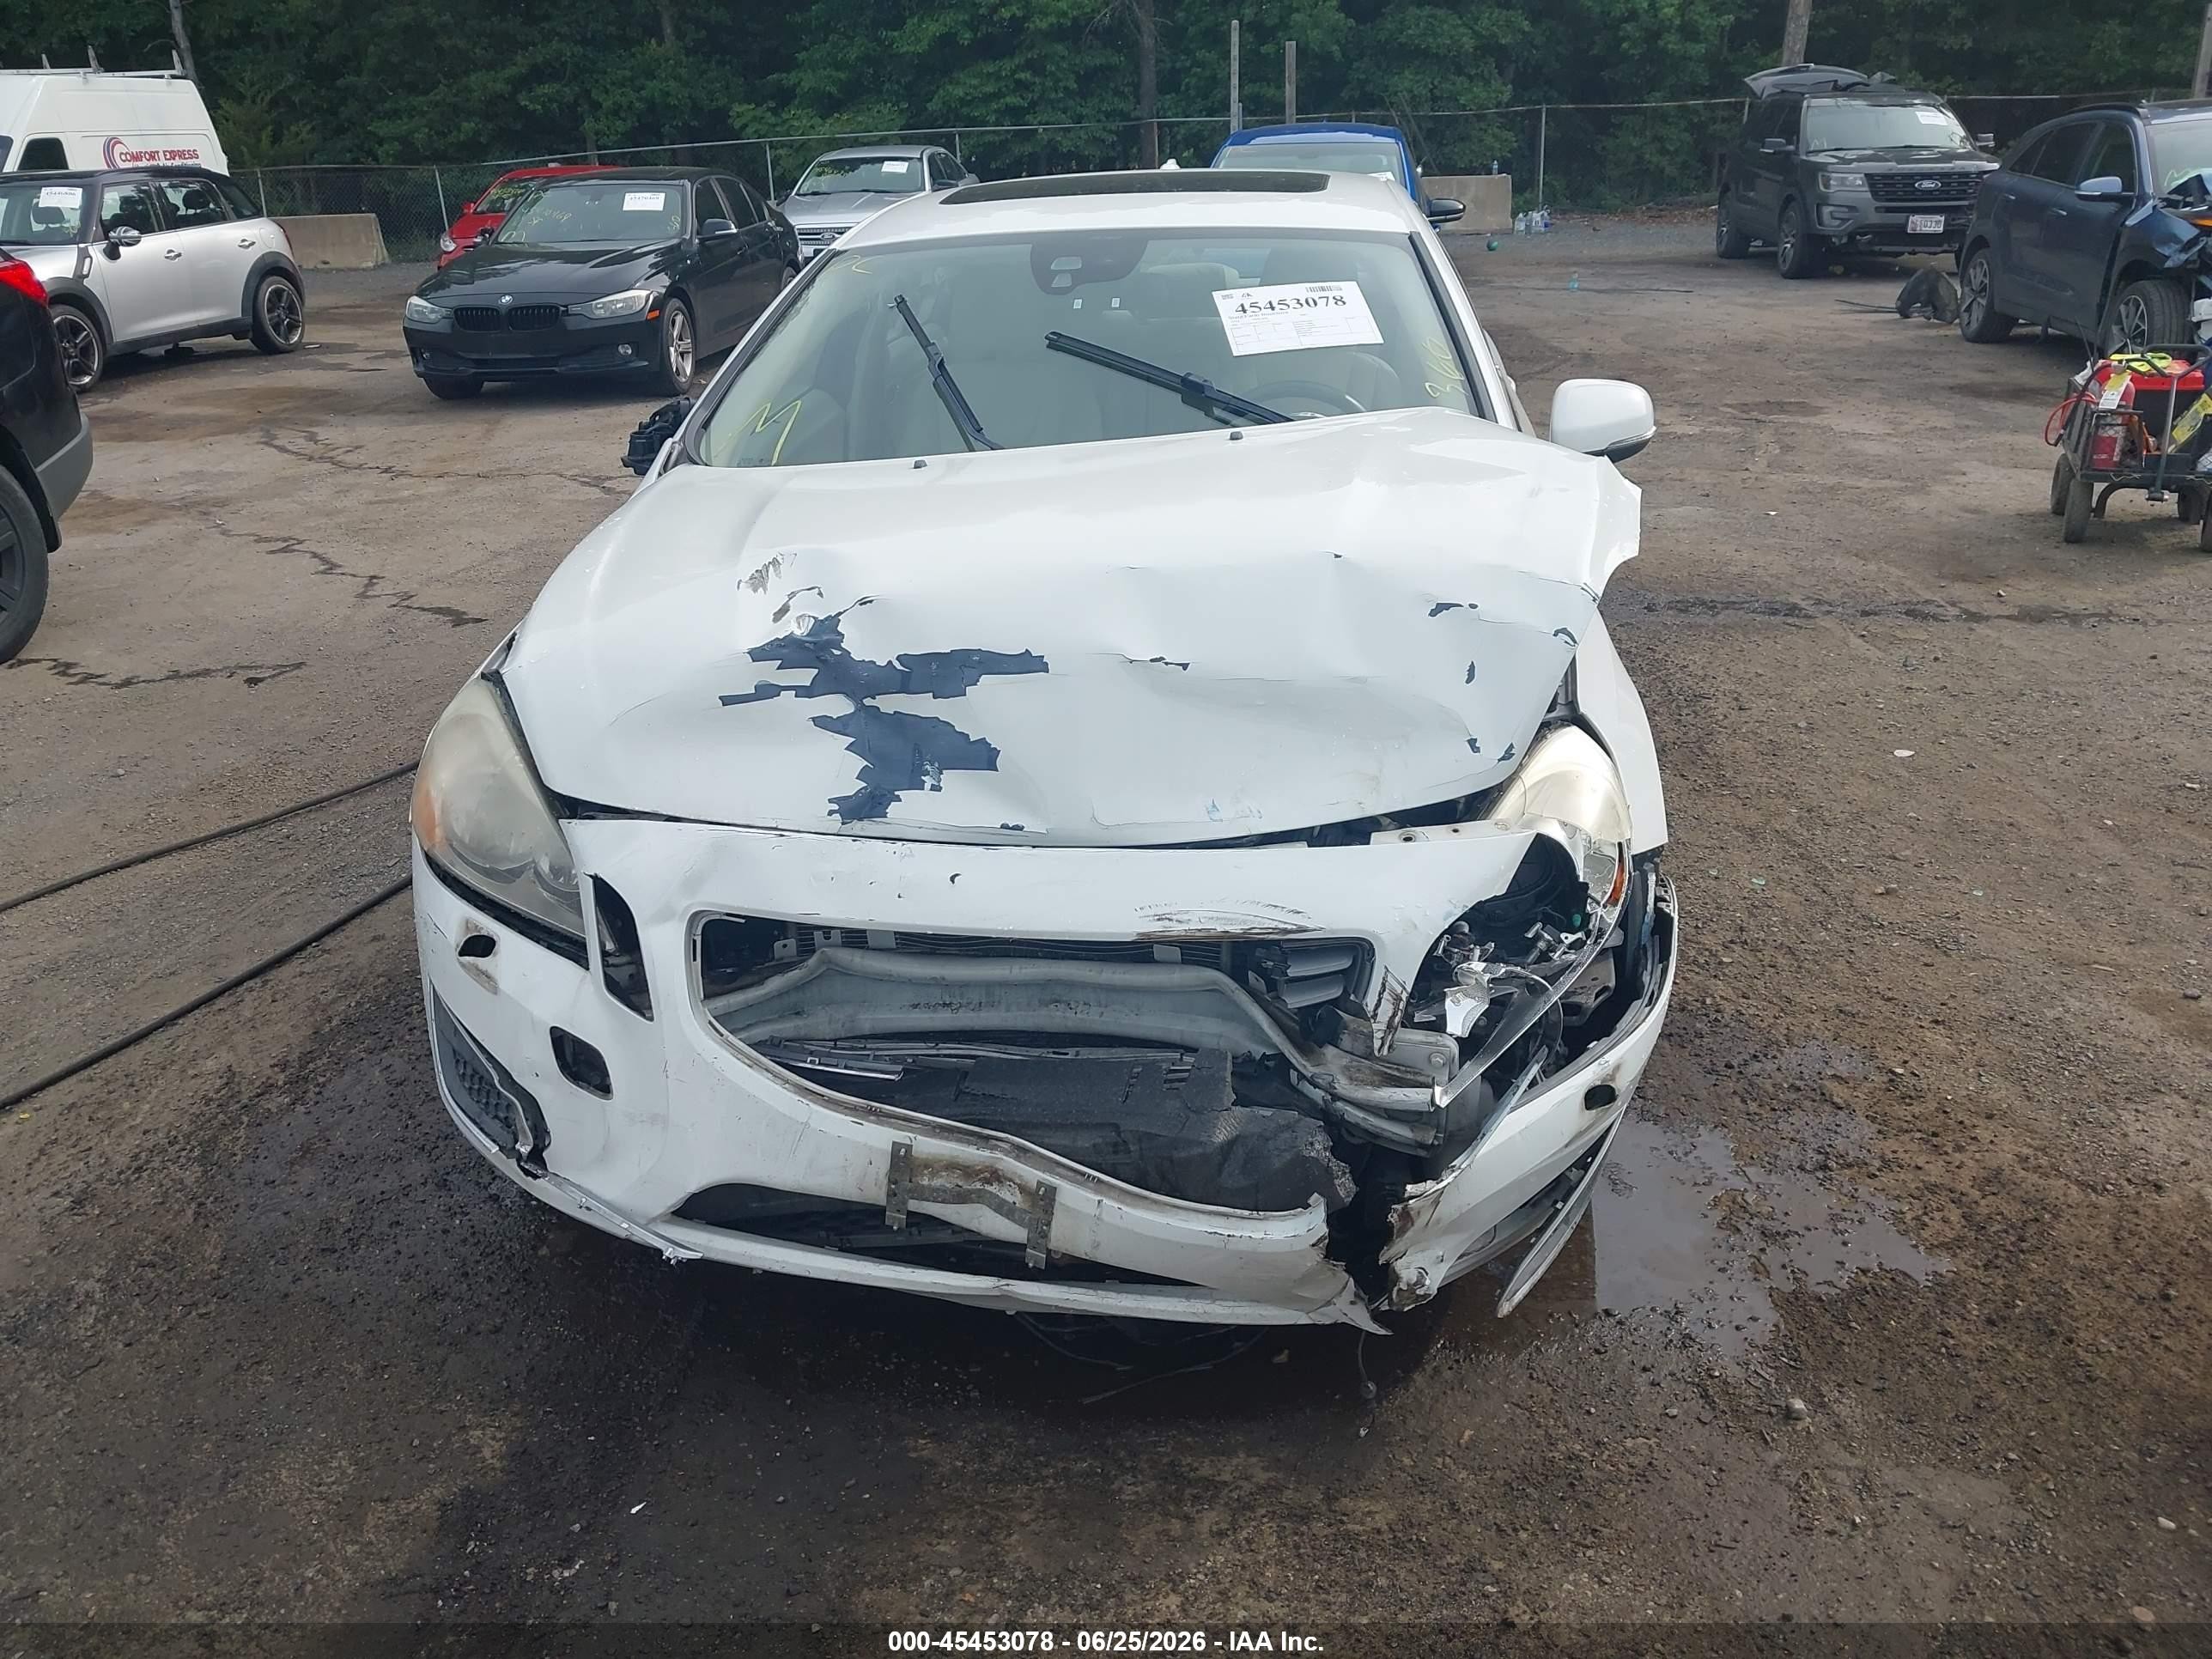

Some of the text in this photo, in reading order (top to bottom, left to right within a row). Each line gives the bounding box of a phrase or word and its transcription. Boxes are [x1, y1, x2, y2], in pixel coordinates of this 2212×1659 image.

[119, 149, 199, 163] COMFORT EXPRESS
[1235, 295, 1346, 314] 45453078
